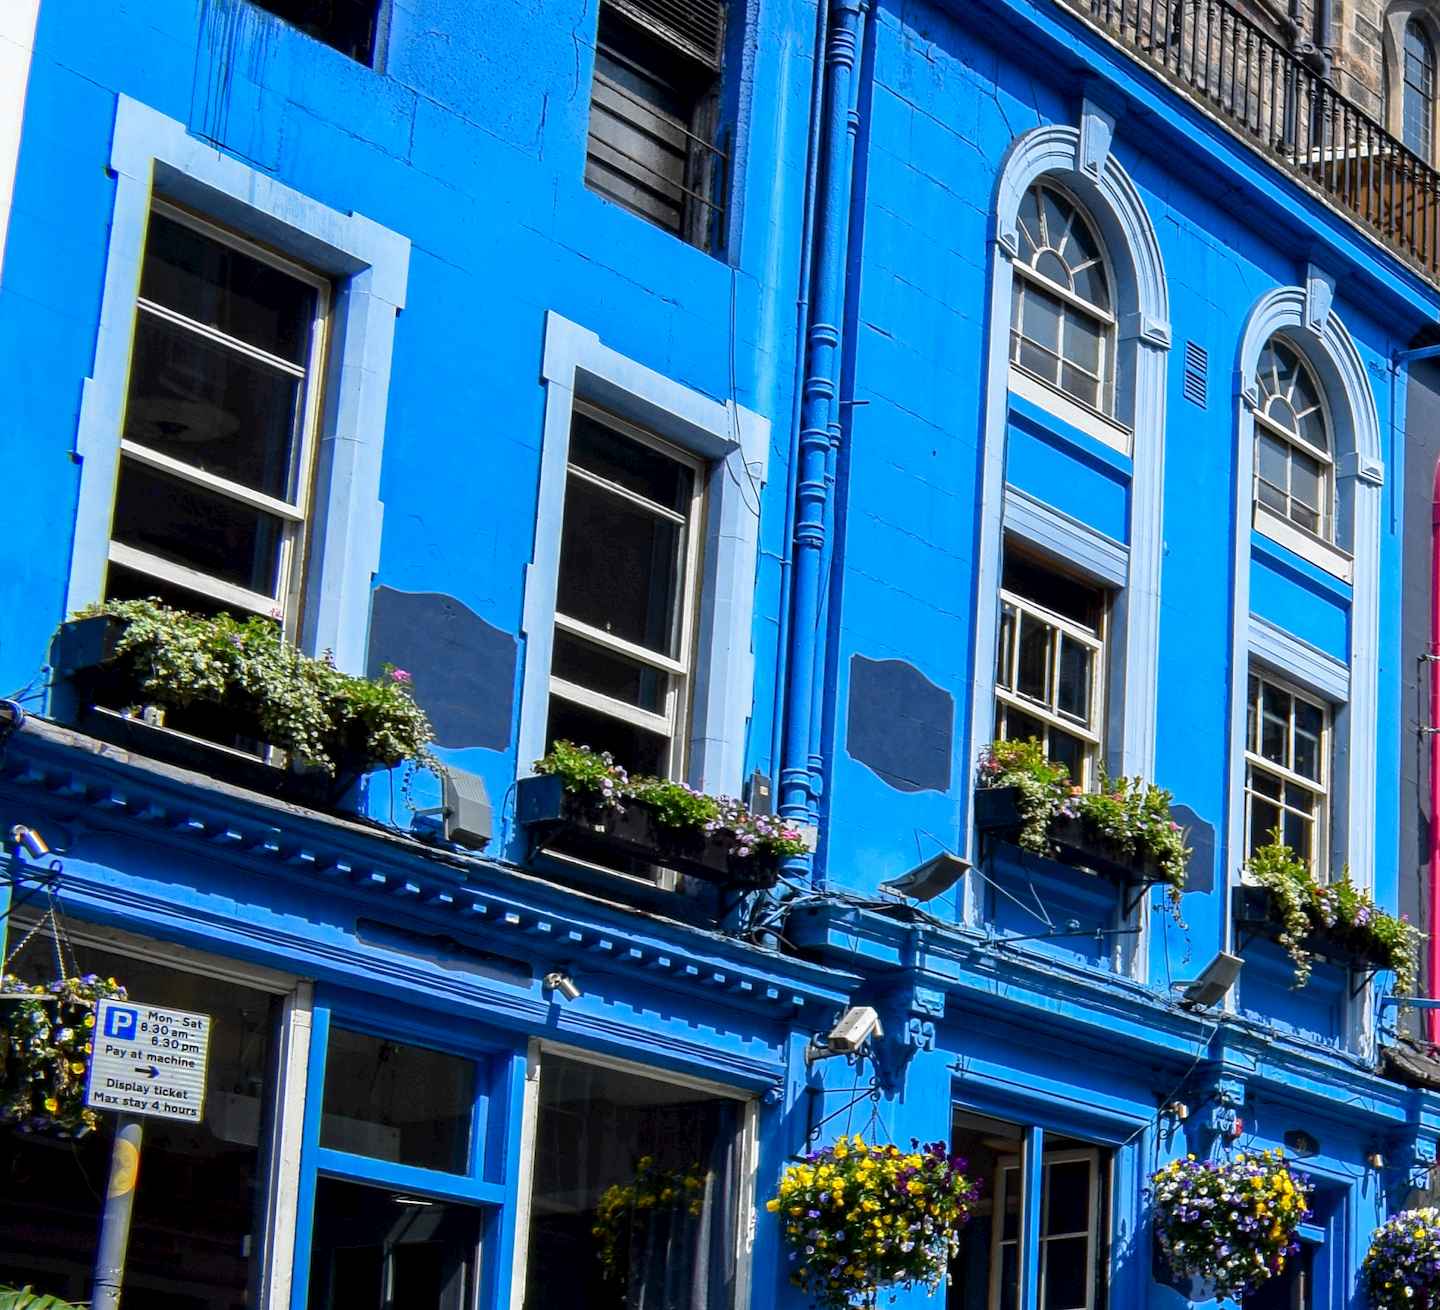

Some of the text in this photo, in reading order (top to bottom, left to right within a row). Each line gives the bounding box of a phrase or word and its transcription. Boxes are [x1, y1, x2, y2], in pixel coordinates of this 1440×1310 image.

[111, 1010, 133, 1035] P
[141, 1022, 169, 1035] 8.30
[171, 1029, 188, 1039] am
[148, 1011, 173, 1024] Mon
[182, 1017, 203, 1029] Sat
[105, 1044, 195, 1068] Pay at machine
[181, 1043, 199, 1053] pm
[106, 1078, 188, 1099] Display ticket
[94, 1091, 197, 1116] Max stay 4 hours
